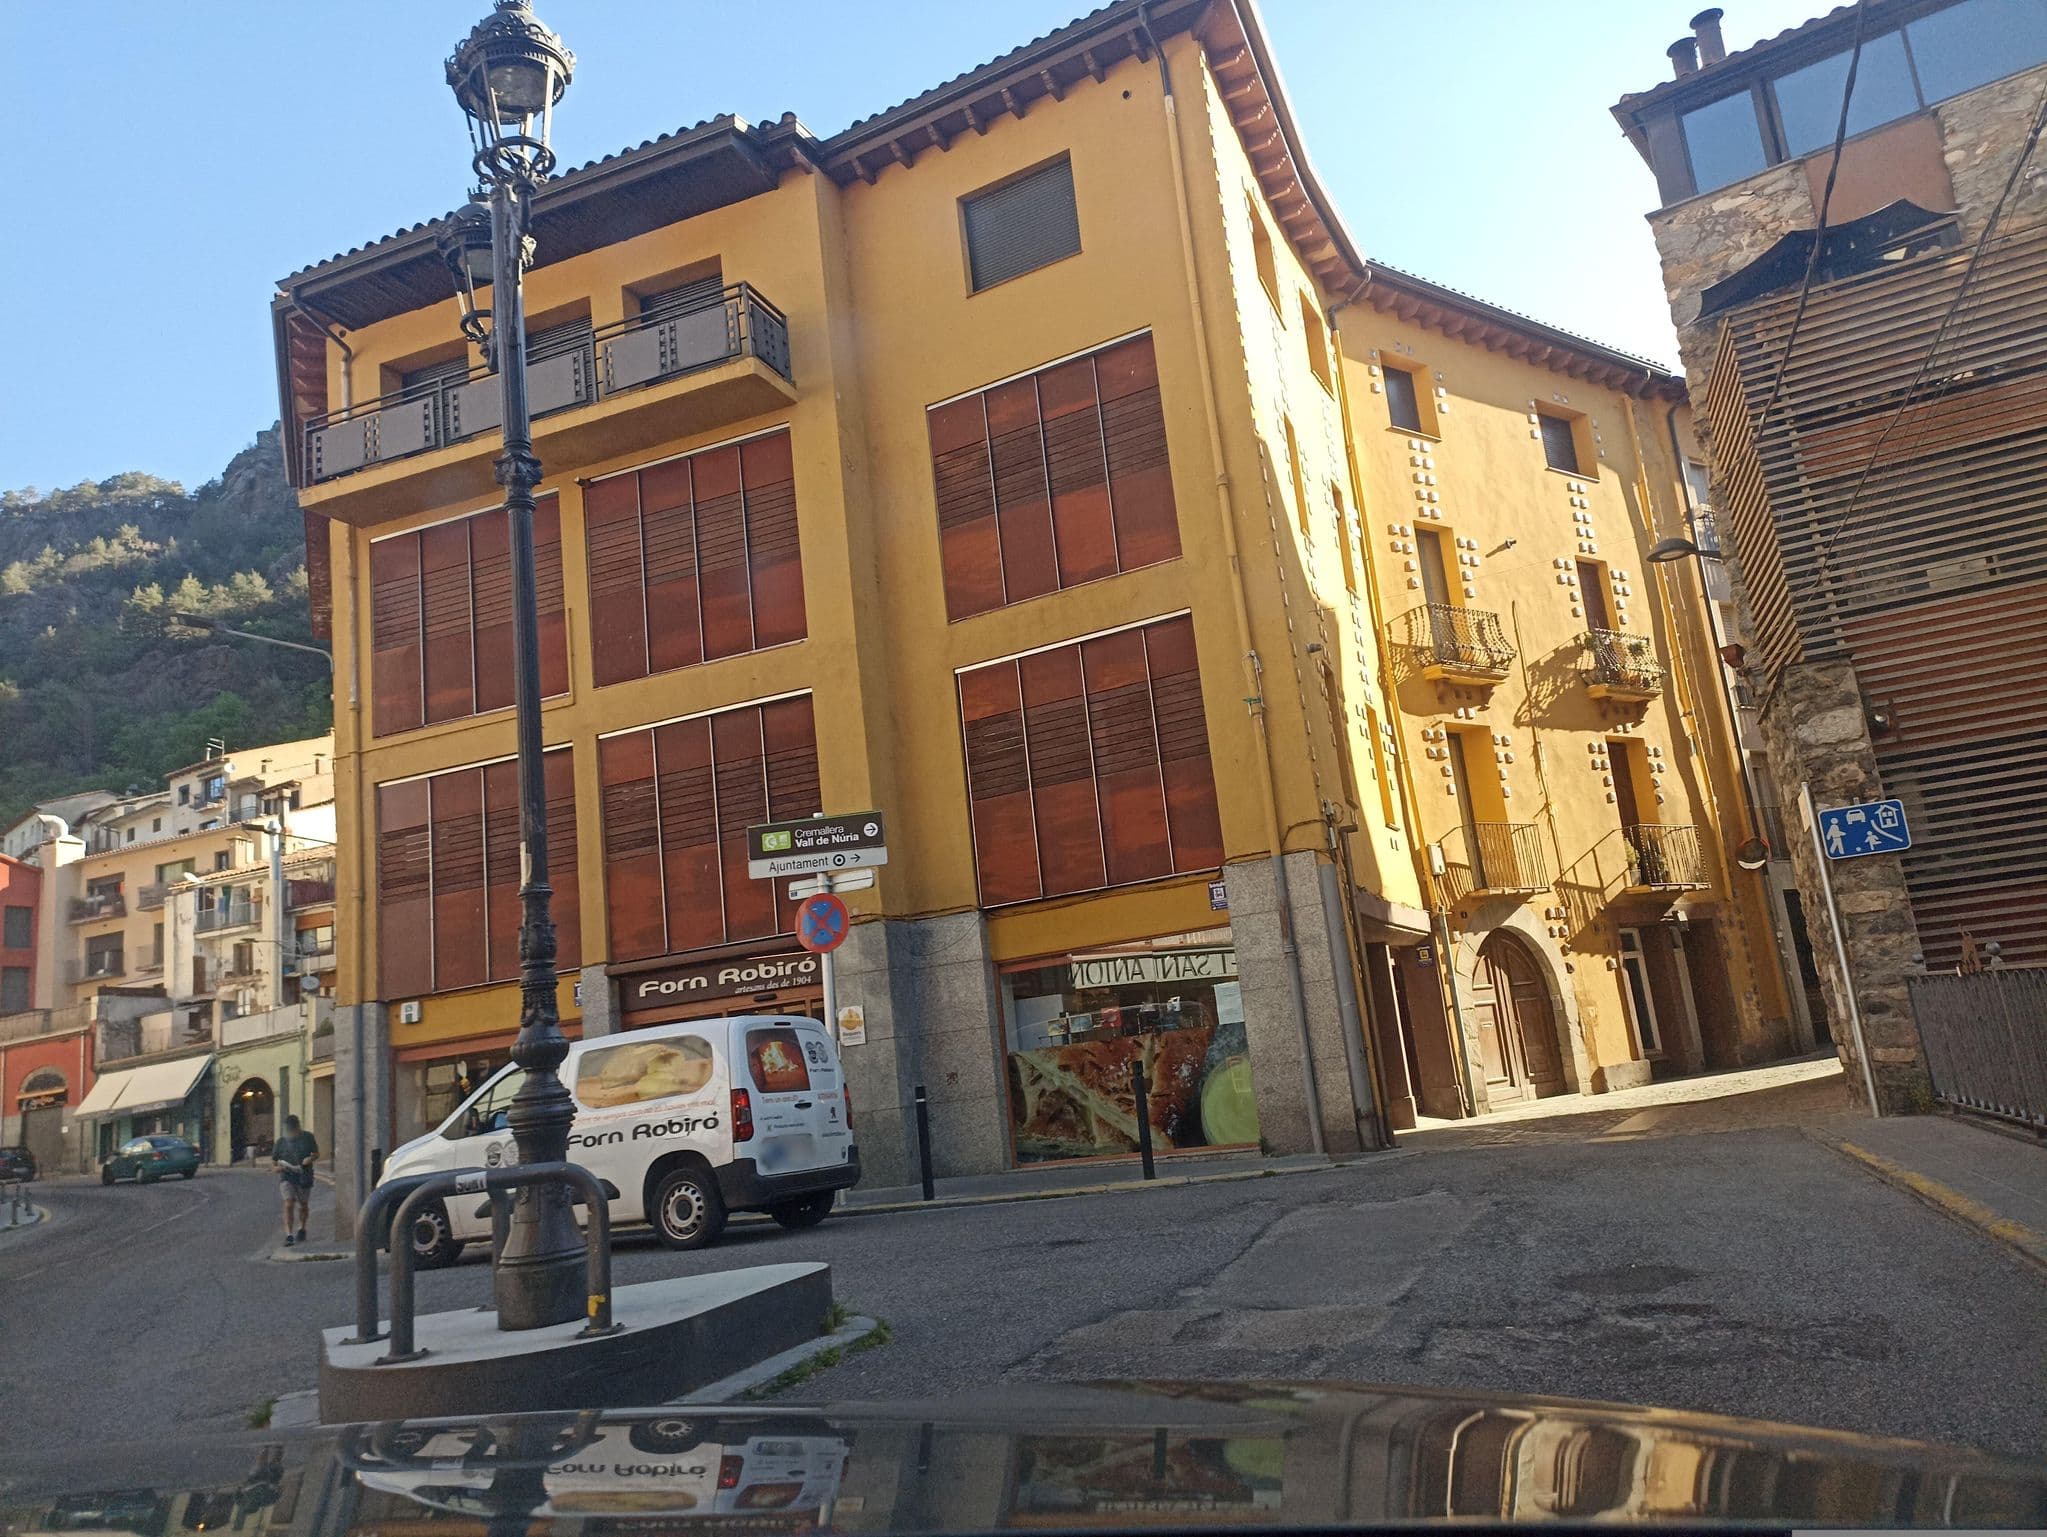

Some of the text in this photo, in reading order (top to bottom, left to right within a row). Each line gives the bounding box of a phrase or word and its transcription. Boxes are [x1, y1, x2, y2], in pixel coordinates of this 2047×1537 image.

[795, 826, 844, 838] Cremallera
[795, 833, 859, 848] Vall de Núria
[769, 857, 829, 874] Ajuntament
[638, 956, 817, 998] Forn Robiró
[766, 980, 779, 990] des
[780, 978, 790, 988] de
[792, 975, 812, 986] 1904
[568, 1131, 623, 1148] Forn
[632, 1110, 720, 1140] Robiró
